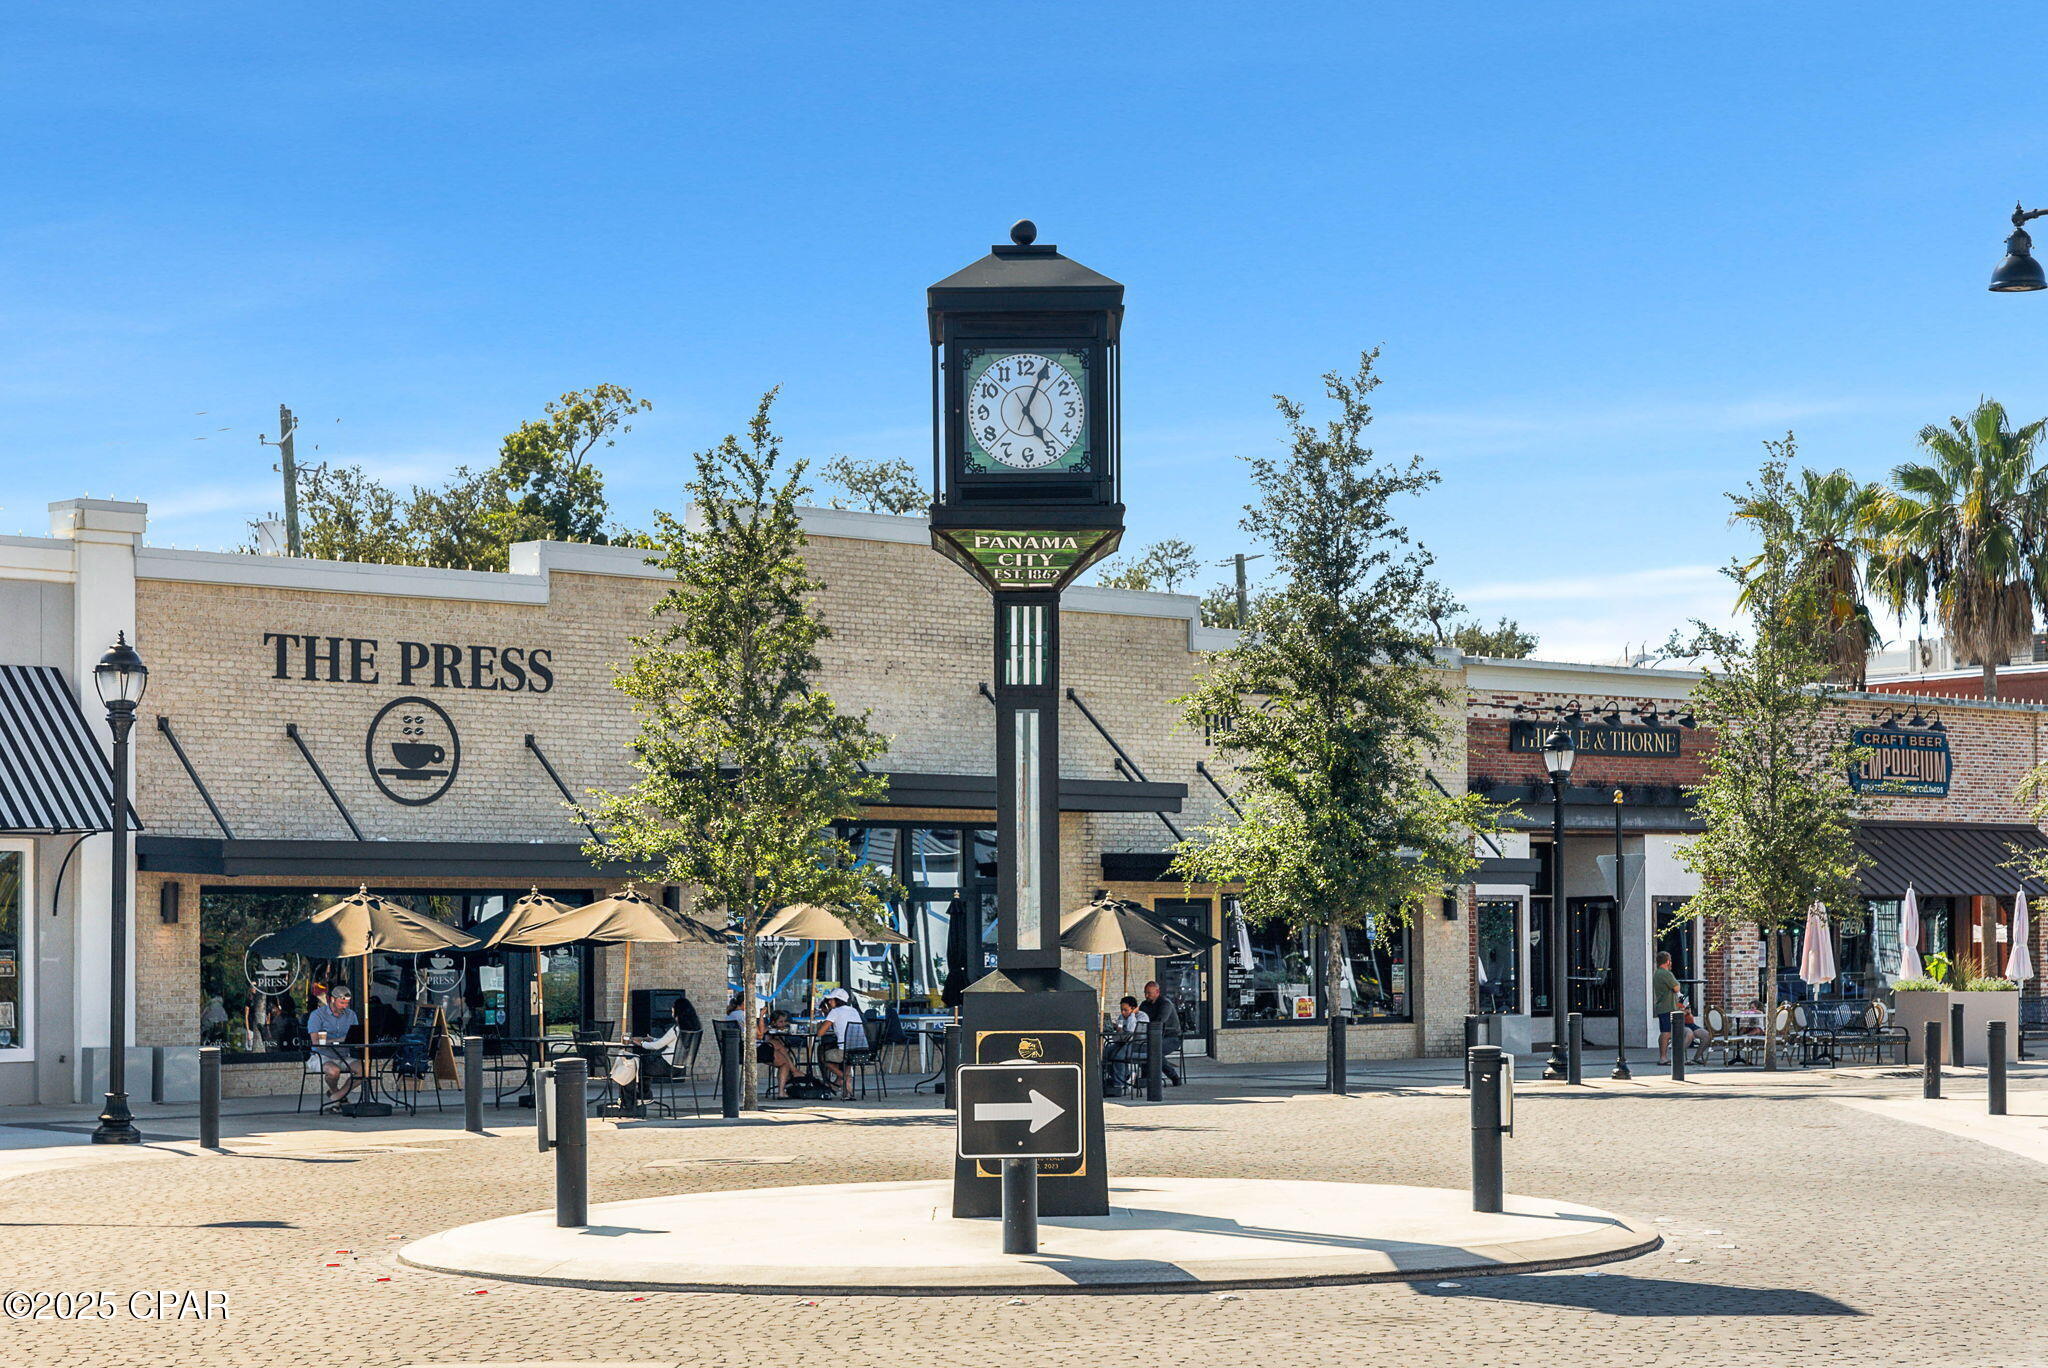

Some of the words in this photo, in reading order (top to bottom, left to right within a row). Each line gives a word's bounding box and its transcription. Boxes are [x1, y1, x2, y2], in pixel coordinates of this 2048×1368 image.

[998, 366, 1010, 382] 11
[1017, 359, 1035, 376] 12
[981, 383, 998, 399] 10
[1058, 380, 1070, 396] 2
[977, 404, 990, 420] 9
[1064, 401, 1076, 418] 3
[983, 425, 996, 442] 8
[1060, 422, 1072, 438] 4
[1000, 442, 1012, 458] 7
[1022, 447, 1034, 463] 6
[1044, 440, 1056, 457] 5
[974, 536, 1078, 549] PANAMA
[998, 553, 1054, 567] CITY
[994, 569, 1024, 580] EST.
[264, 632, 379, 684] THE
[397, 641, 554, 693] PRESS
[1593, 733, 1605, 750] &
[1610, 731, 1677, 753] THORNE
[1863, 733, 1905, 745] CRAFT
[1909, 736, 1942, 747] BEER
[1860, 748, 1947, 782] EMPOURIUM
[258, 978, 288, 987] PRESS
[427, 975, 454, 985] PRESS
[203, 1038, 232, 1048] Coffee
